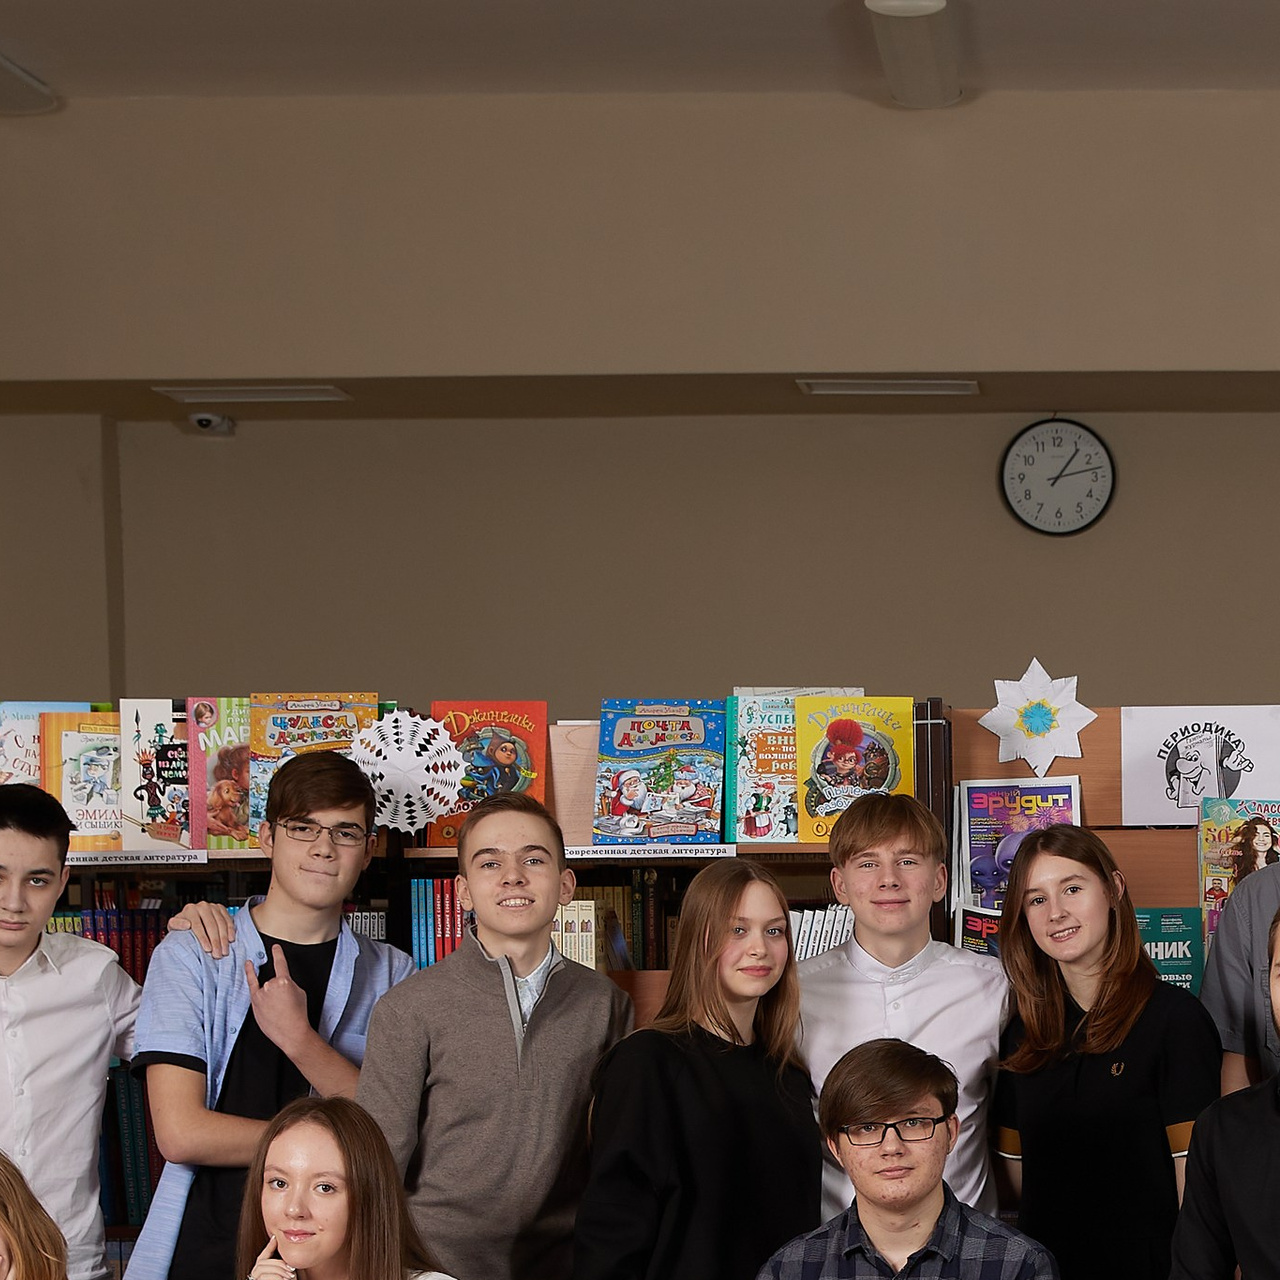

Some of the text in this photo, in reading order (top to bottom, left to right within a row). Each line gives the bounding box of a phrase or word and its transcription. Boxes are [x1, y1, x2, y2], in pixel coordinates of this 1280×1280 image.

[1036, 441, 1045, 453] 11
[1052, 436, 1063, 448] 12
[1023, 455, 1035, 466] 10
[1085, 454, 1092, 465] 2
[1018, 473, 1025, 484] 9
[1091, 472, 1098, 482] 3
[1024, 489, 1031, 500] 8
[1086, 488, 1093, 499] 4
[1037, 503, 1044, 514] 7
[1055, 507, 1062, 519] 6
[1076, 502, 1083, 514] 5
[272, 714, 357, 730] ЧУДЕСА
[807, 702, 902, 731] Джинглики
[443, 709, 537, 737] Джинглики
[630, 720, 693, 732] ПОЧТА
[1157, 722, 1244, 760] ПЕРИОДИКА
[25, 748, 40, 760] ПА
[564, 846, 728, 857] Современная детская литература
[102, 855, 141, 863] детская
[143, 853, 199, 863] литература
